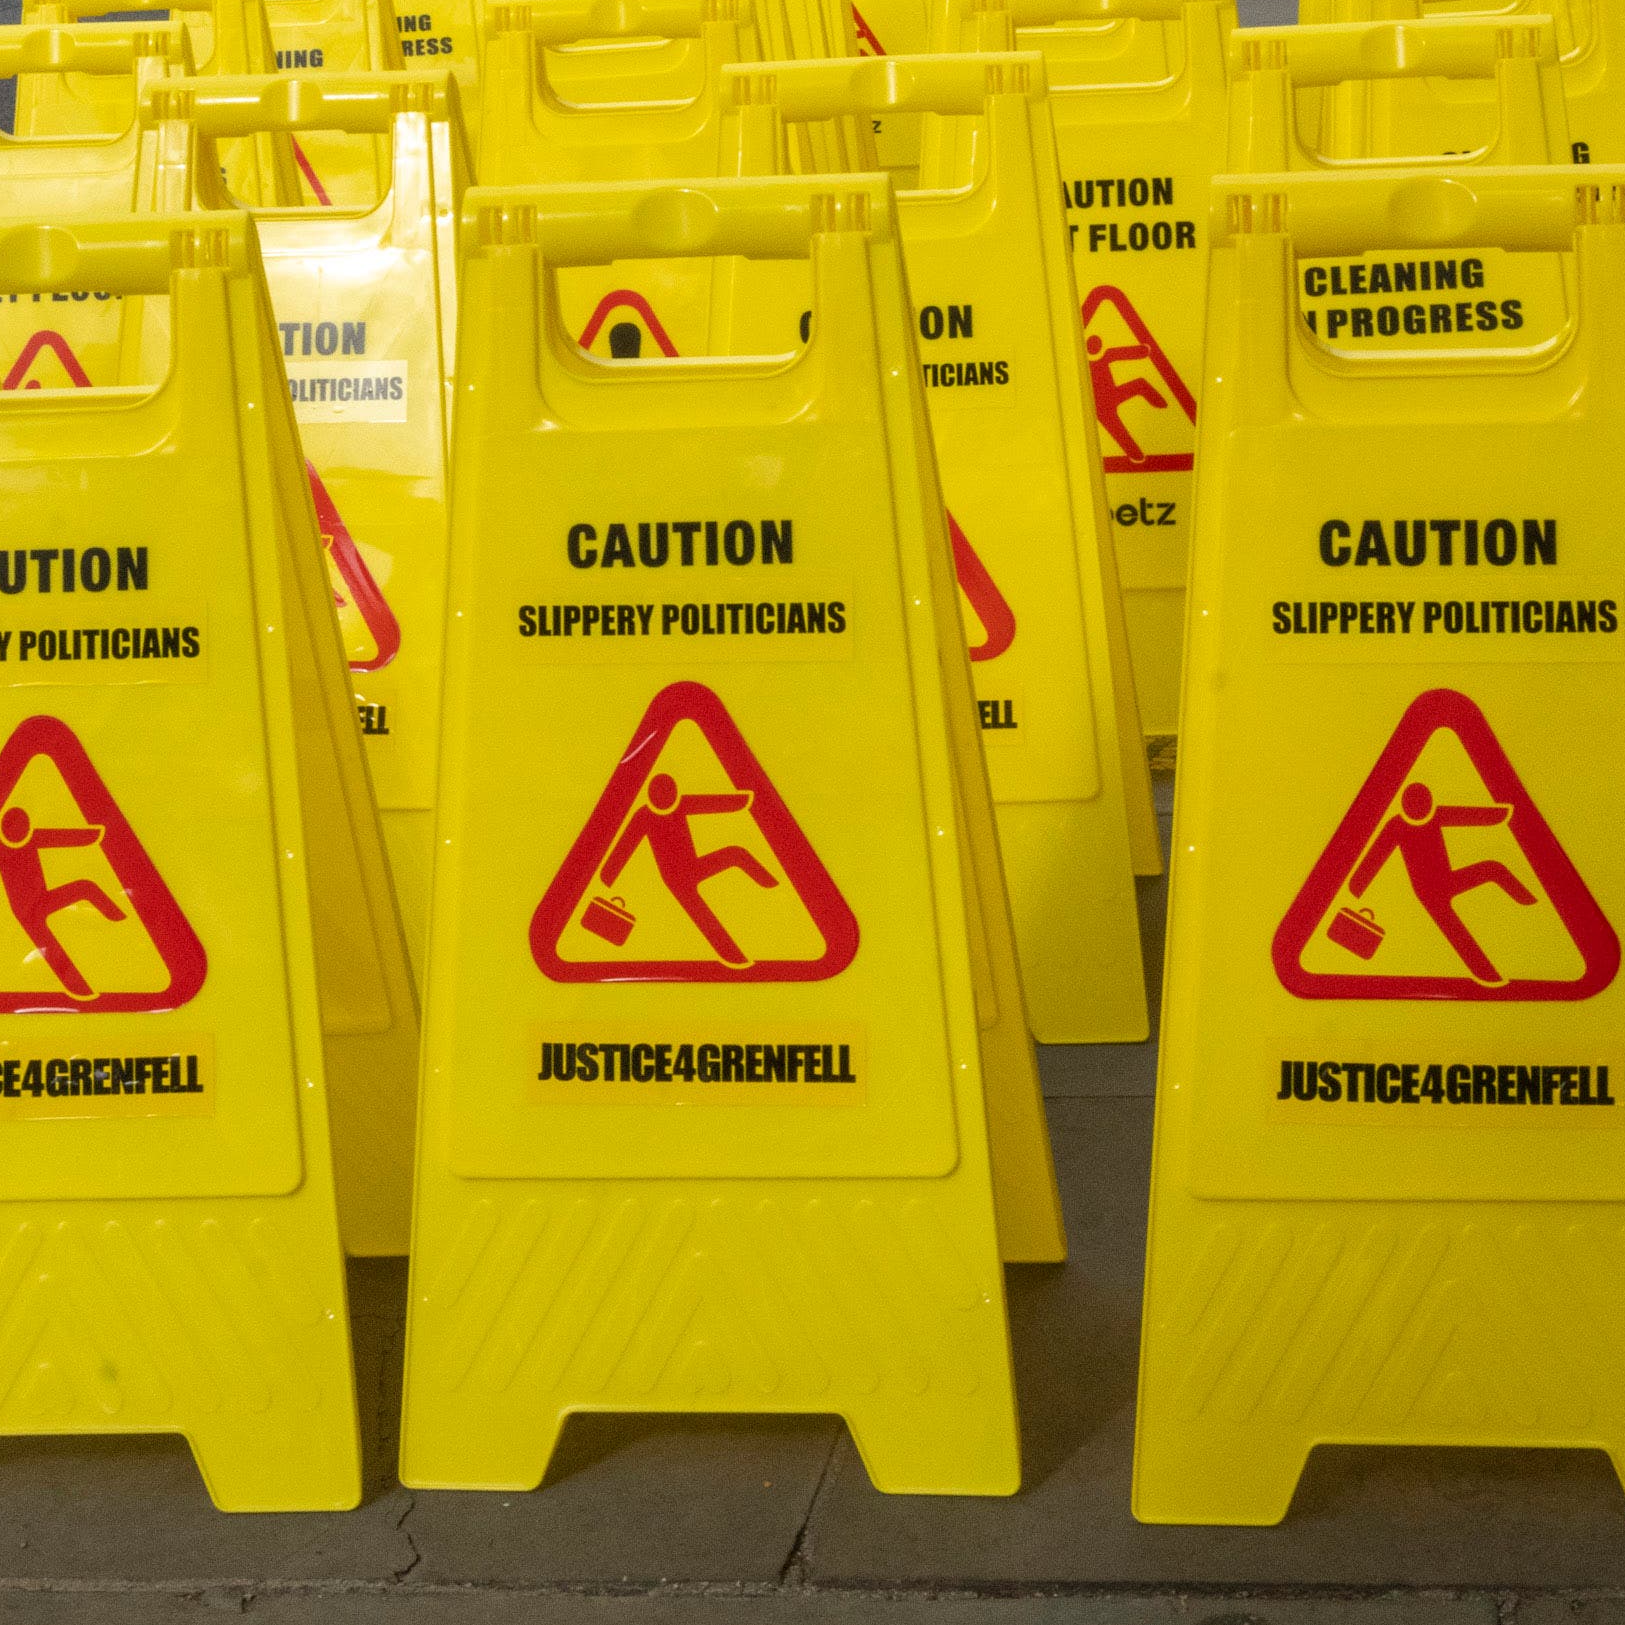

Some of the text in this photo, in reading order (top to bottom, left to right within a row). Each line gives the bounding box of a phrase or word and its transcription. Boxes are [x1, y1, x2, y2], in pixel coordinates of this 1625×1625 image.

[402, 37, 453, 57] RESS
[1090, 222, 1195, 251] FLOOR
[1305, 259, 1483, 296] CLEANING
[1328, 300, 1523, 338] PROGRESS
[278, 318, 368, 358] TION
[287, 374, 404, 403] OLITICIANS
[568, 520, 792, 568] CAUTION
[1320, 519, 1556, 566] CAUTION
[519, 602, 845, 636] SLIPPERY POLITICIANS
[1273, 600, 1617, 634] SLIPPERY POLITICIANS
[20, 627, 199, 660] POLITICIANS
[539, 1043, 855, 1082] JUSTICE4GRENFELL
[1278, 1061, 1614, 1105] JUSTICE4GRENFELL
